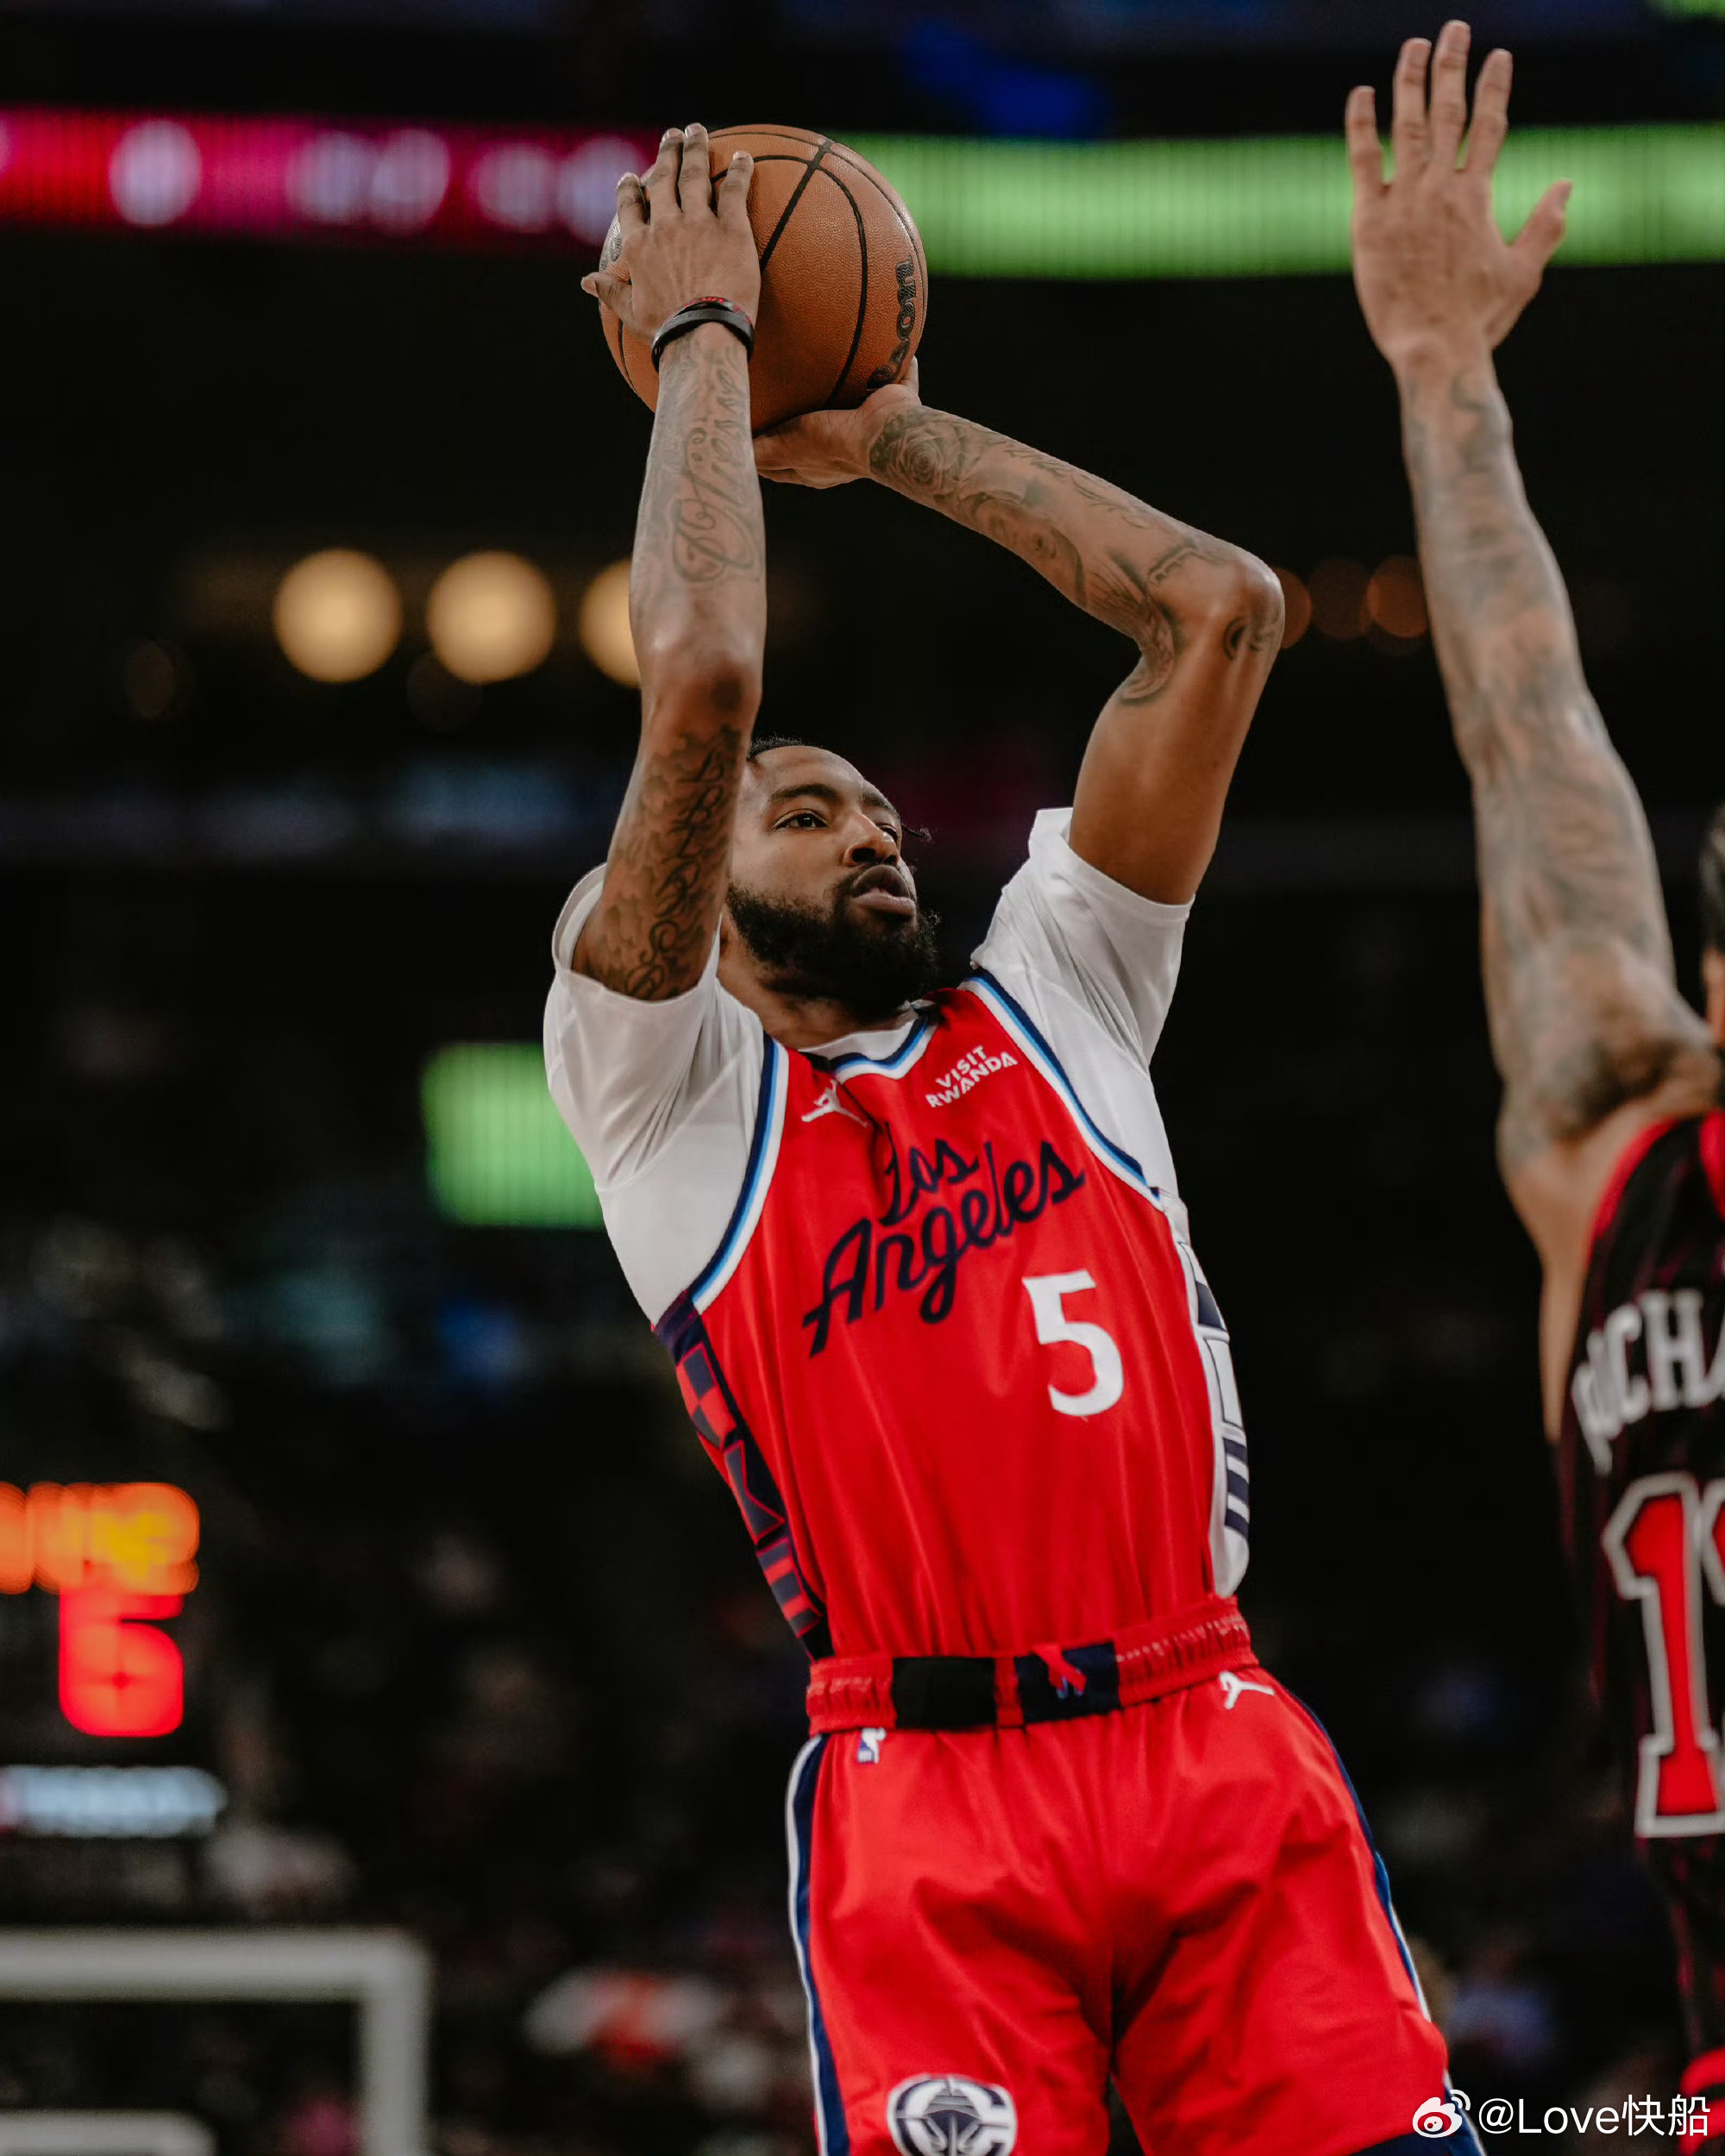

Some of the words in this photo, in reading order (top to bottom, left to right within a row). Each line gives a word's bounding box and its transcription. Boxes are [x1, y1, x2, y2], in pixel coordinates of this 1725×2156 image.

[925, 1051, 1018, 1107] RWANDA
[935, 1045, 987, 1088] VISIT
[802, 1139, 1086, 1359] Angeles
[1021, 1269, 1124, 1416] 5
